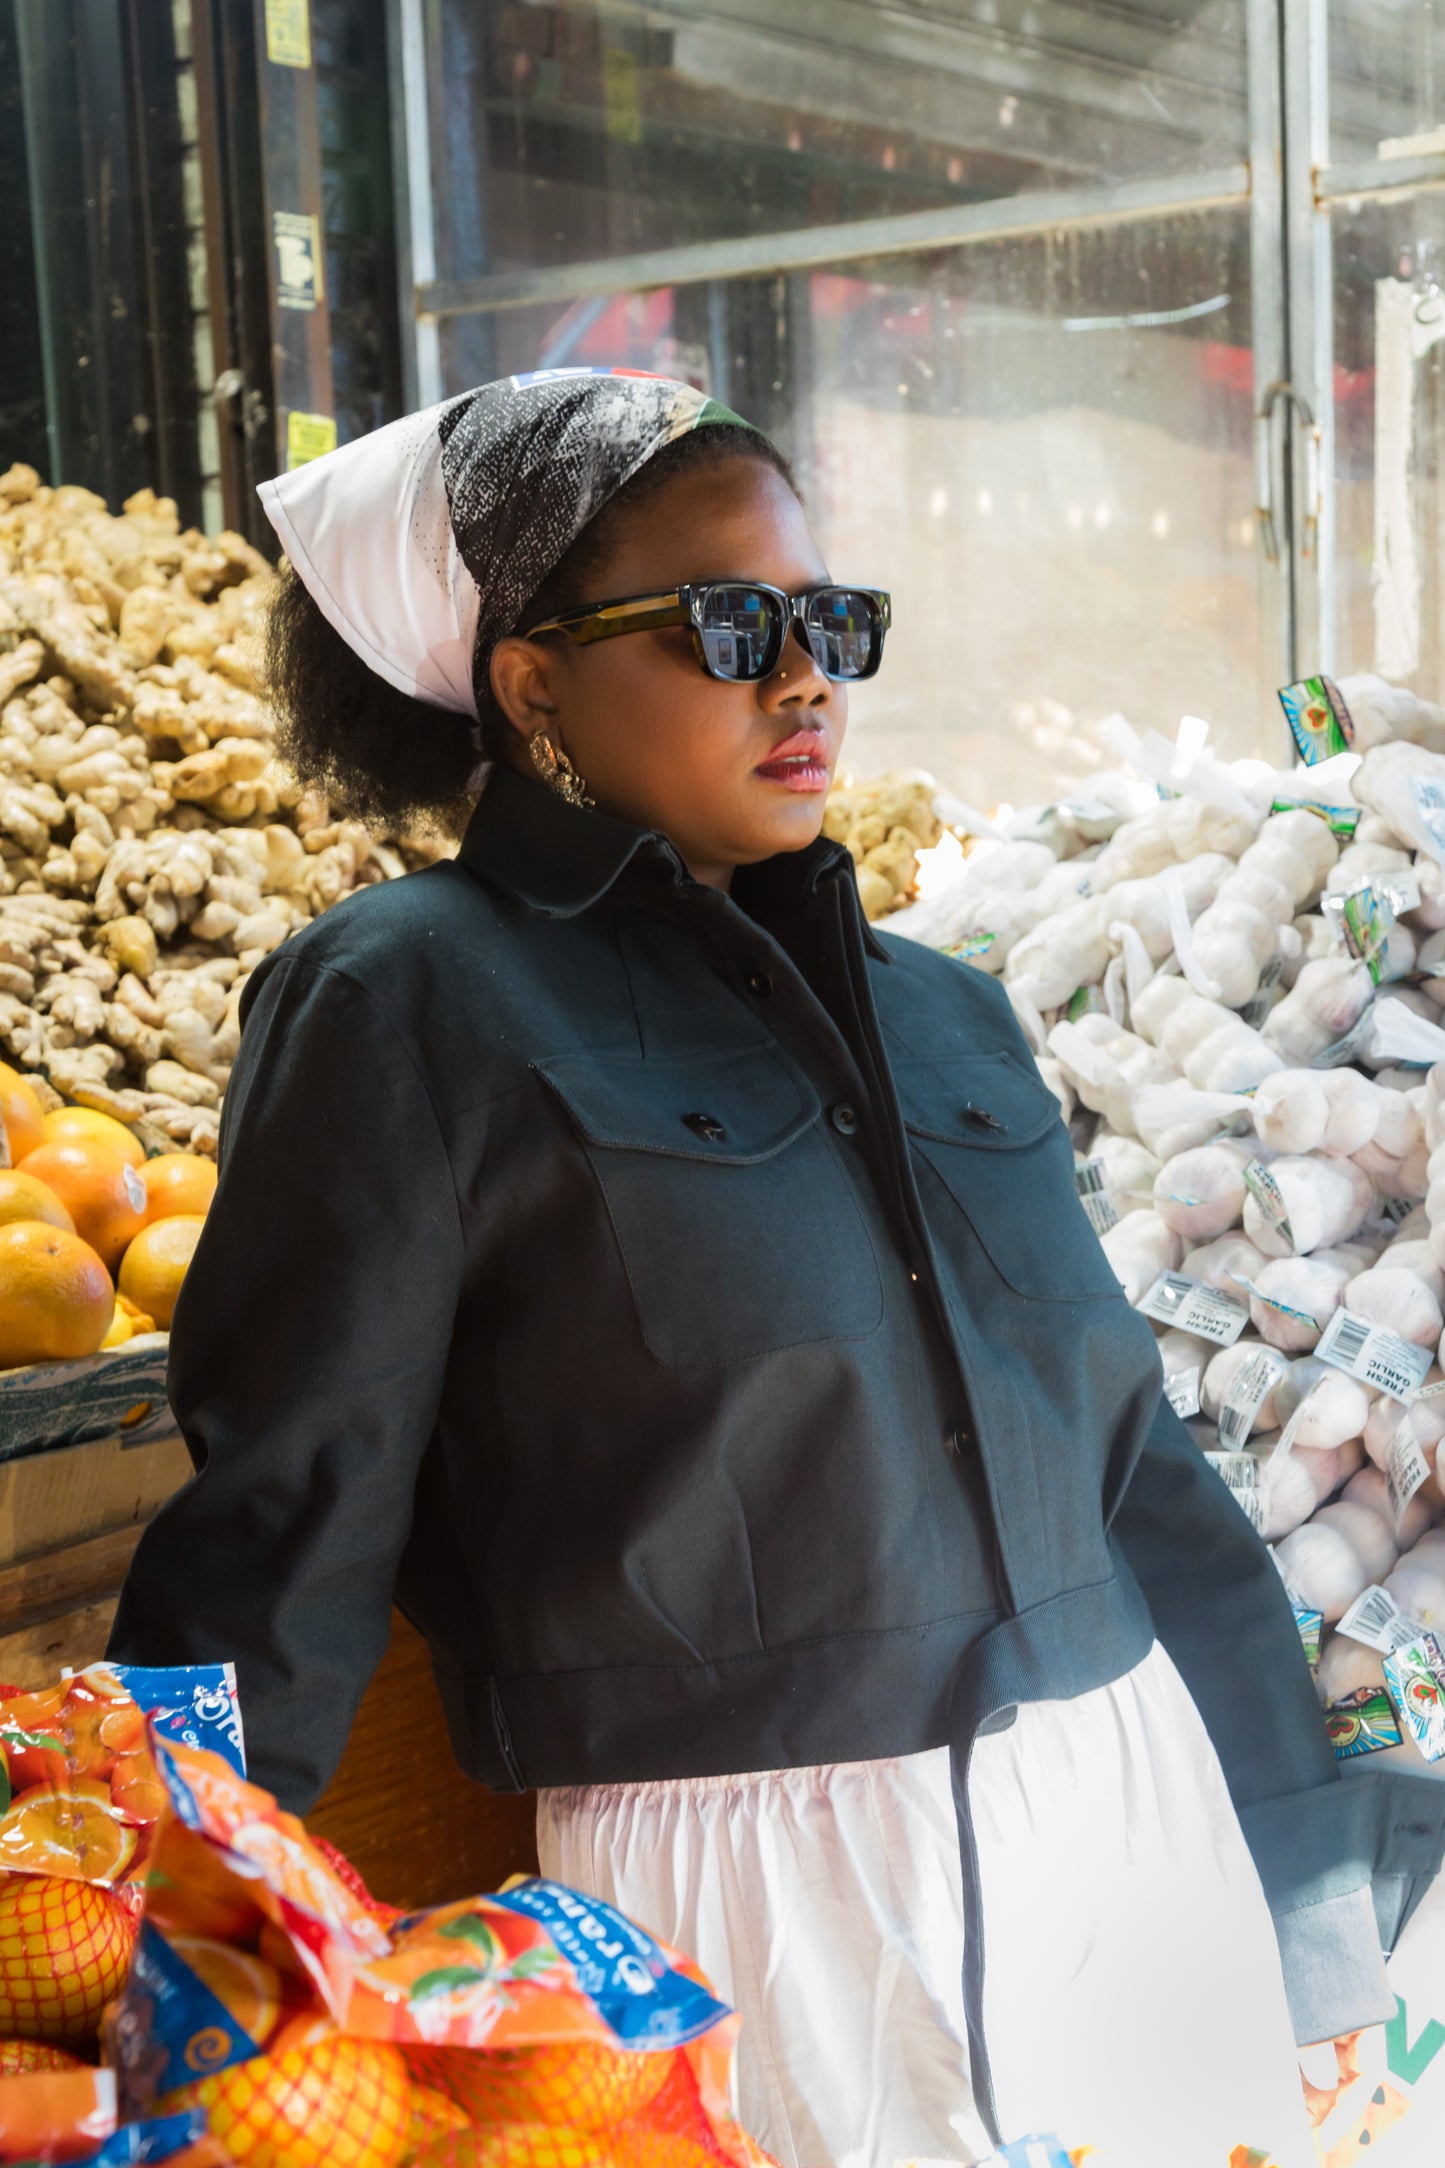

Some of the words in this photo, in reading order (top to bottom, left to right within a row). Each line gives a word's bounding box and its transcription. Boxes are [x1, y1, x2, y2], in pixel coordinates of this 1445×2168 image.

[1184, 1319, 1225, 1337] FRESH
[1187, 1311, 1231, 1329] GARLIC
[1366, 1369, 1405, 1395] FRESH
[1368, 1359, 1411, 1387] GARLIC
